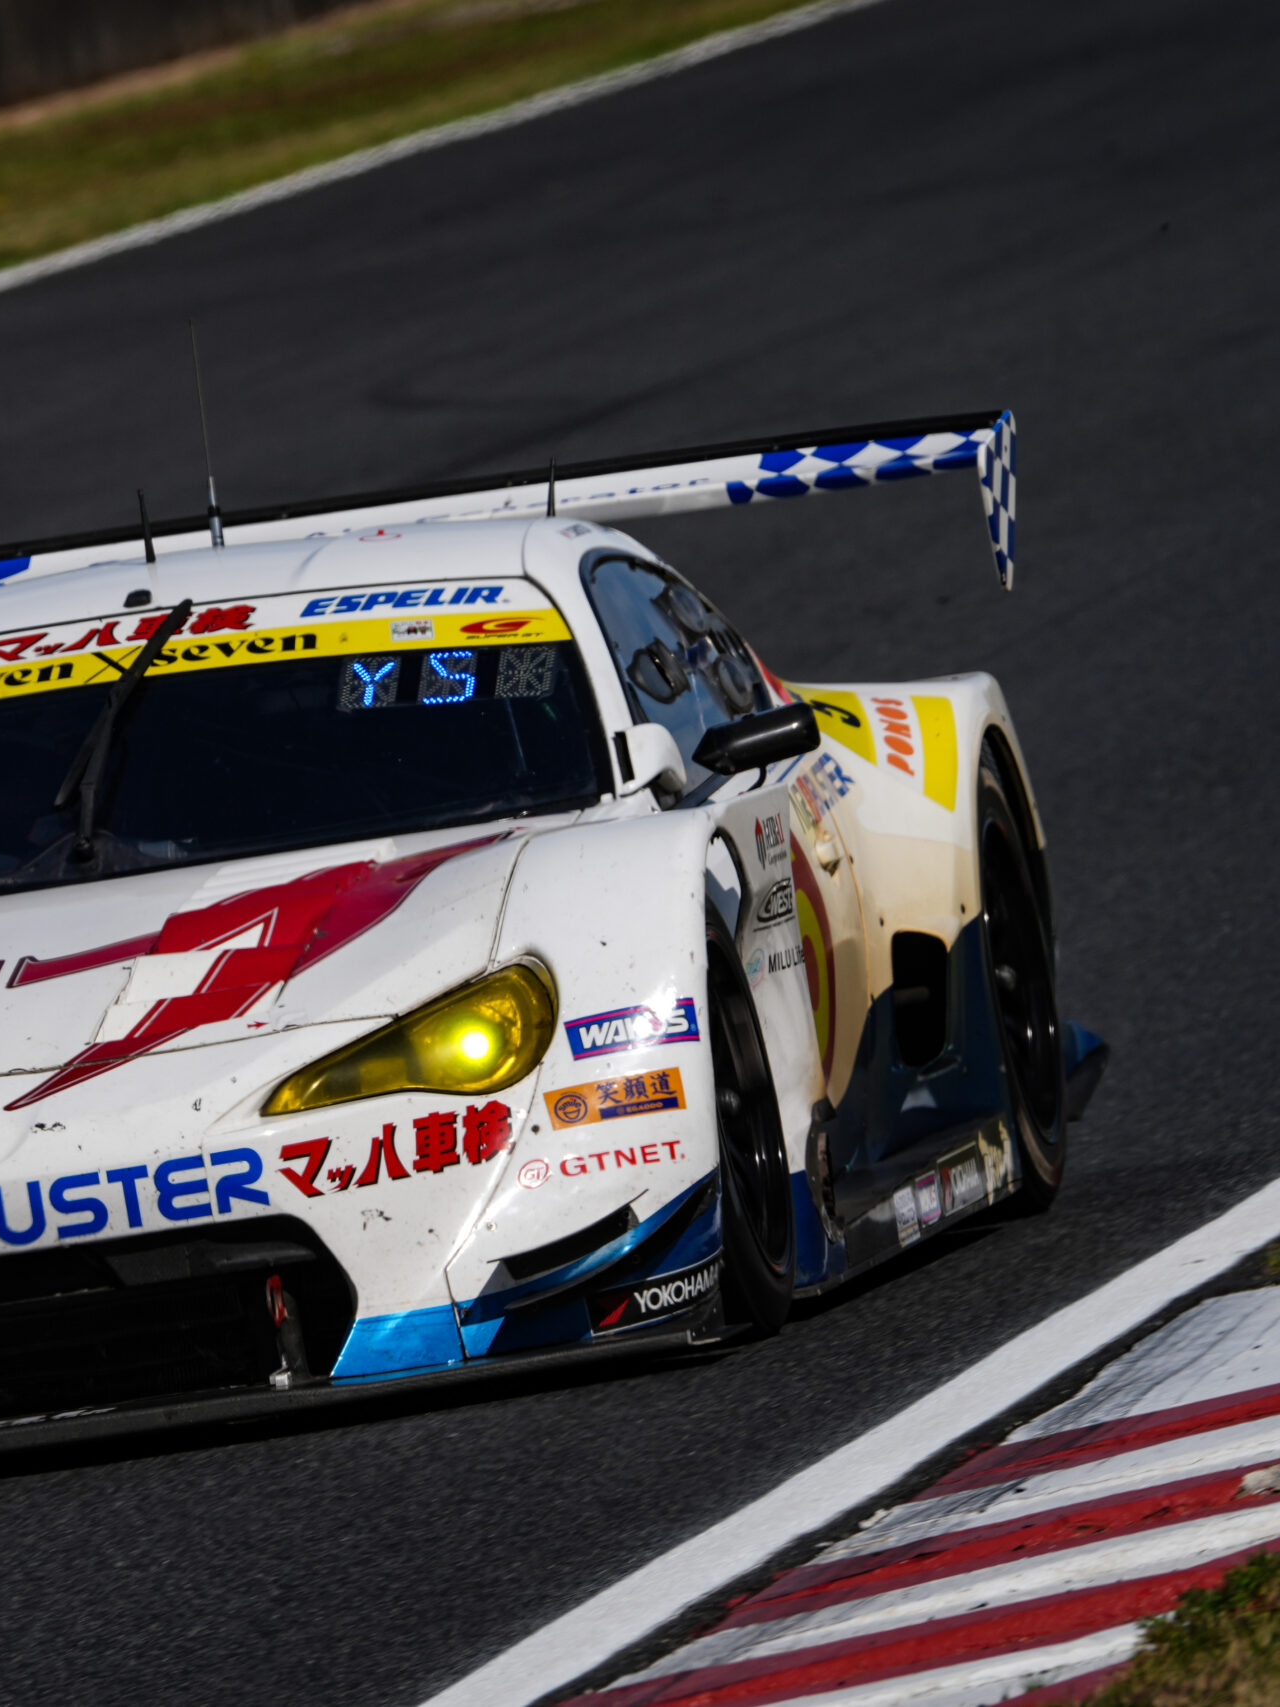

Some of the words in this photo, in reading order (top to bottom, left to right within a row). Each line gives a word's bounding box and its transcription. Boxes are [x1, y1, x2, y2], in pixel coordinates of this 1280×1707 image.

[300, 586, 504, 617] ESPELIR
[149, 631, 318, 669] seven
[871, 697, 915, 776] PONOS
[595, 1072, 678, 1106] 笑顔道
[277, 1099, 516, 1199] マッハ車検
[559, 1140, 682, 1177] GTNET
